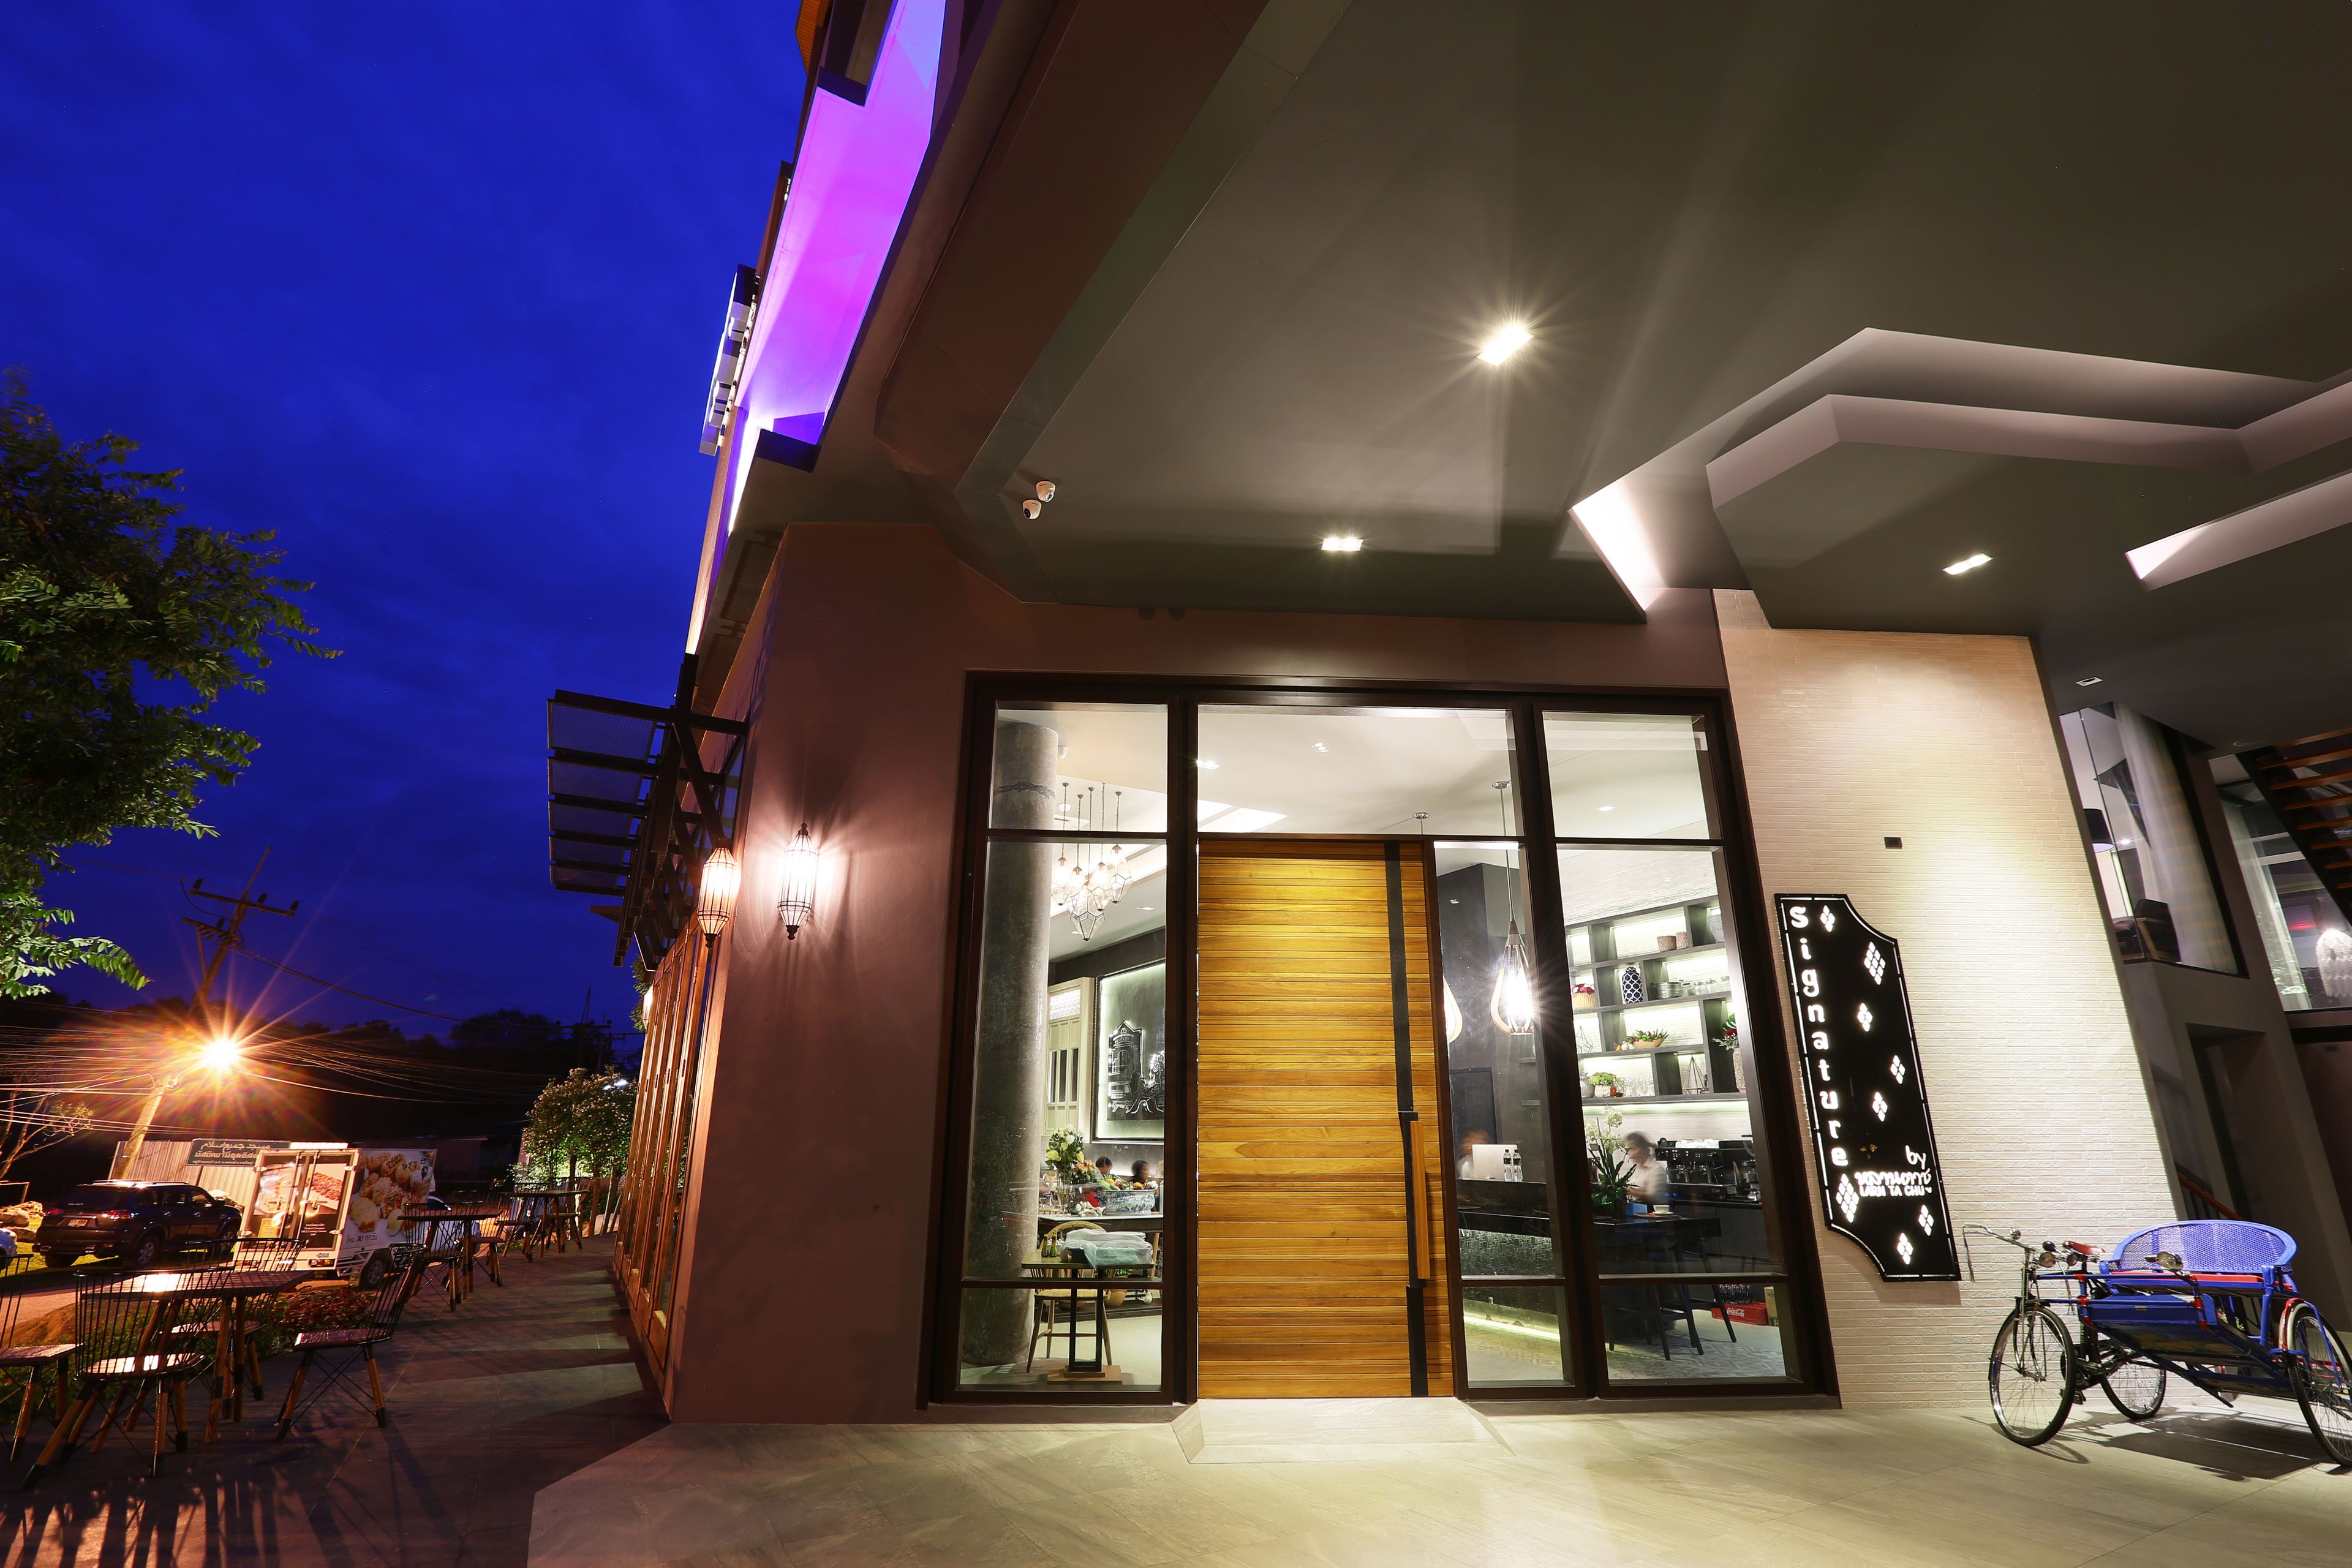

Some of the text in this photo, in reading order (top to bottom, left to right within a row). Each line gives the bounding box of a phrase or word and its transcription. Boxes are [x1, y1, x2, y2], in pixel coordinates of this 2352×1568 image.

[1790, 905, 1848, 1167] Signature
[1905, 1145, 1926, 1170] by
[1859, 1185, 1925, 1197] LARN TA CHU
